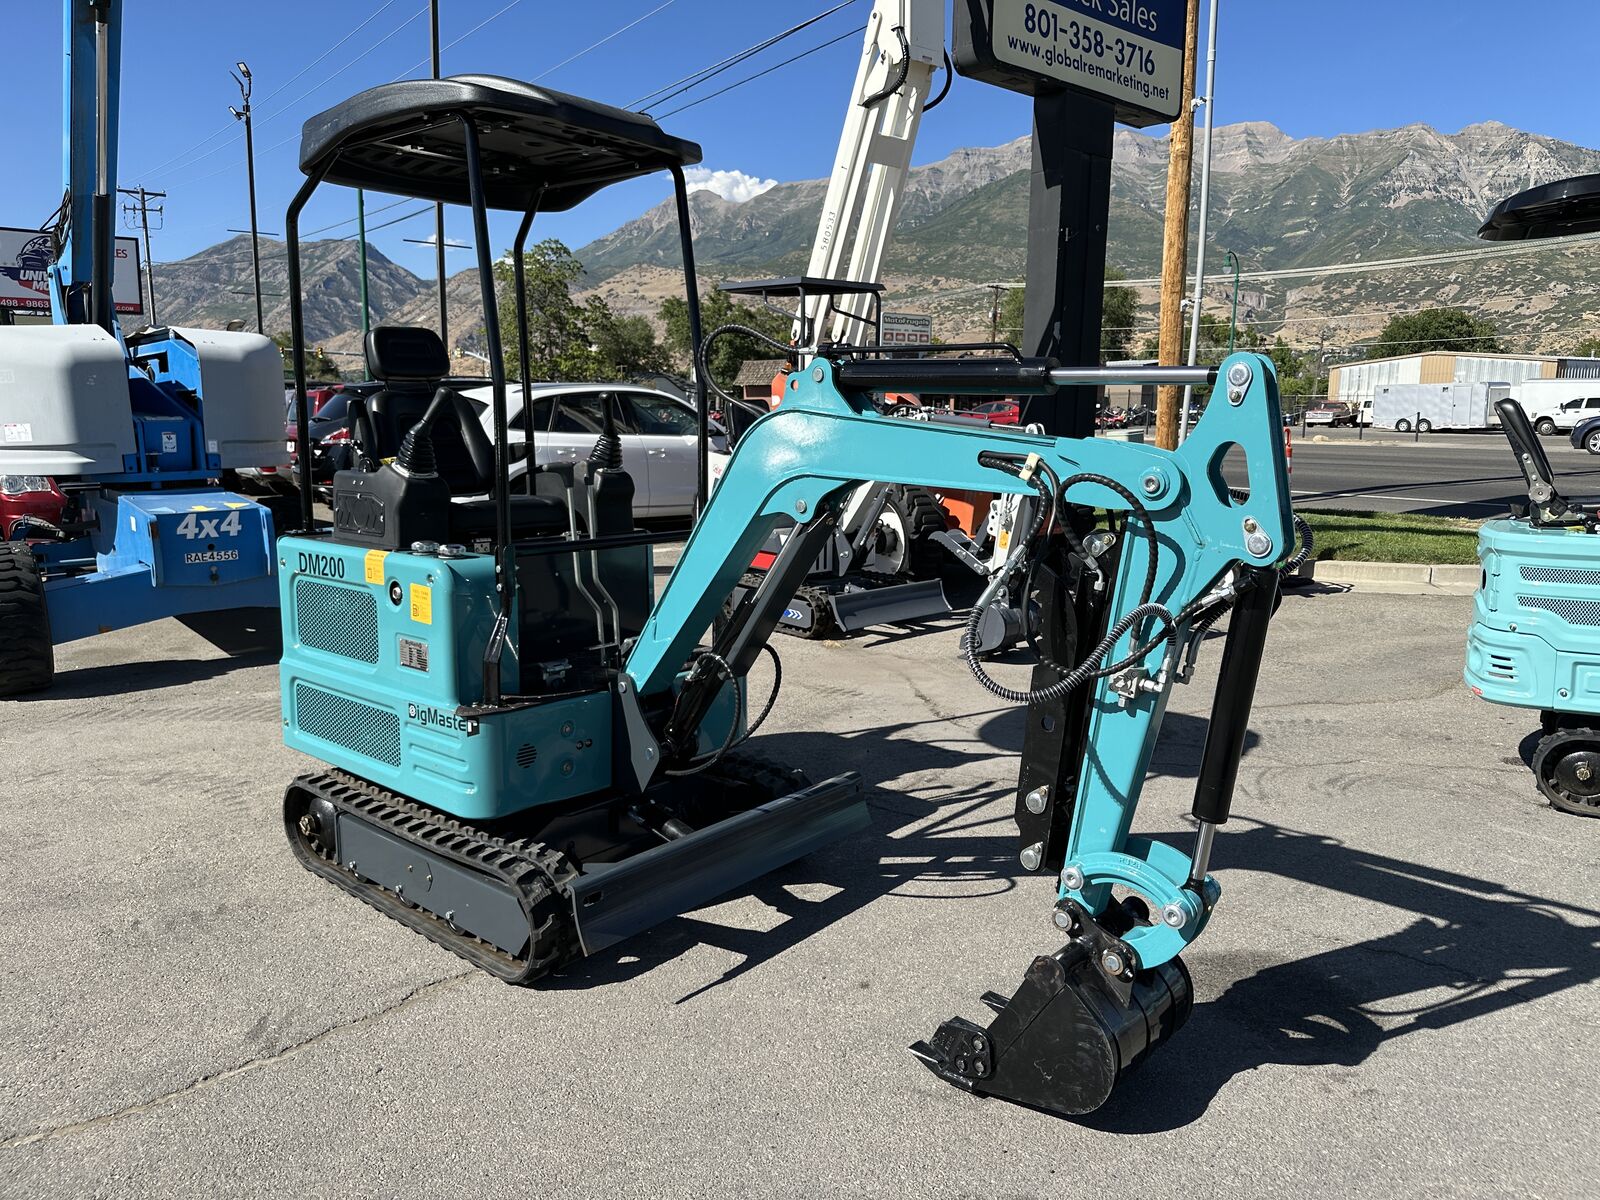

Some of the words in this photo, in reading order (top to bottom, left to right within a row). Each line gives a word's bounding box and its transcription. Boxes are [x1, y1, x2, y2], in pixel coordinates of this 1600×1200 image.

[1108, 0, 1157, 32] Sales
[1024, 3, 1156, 76] 801-358-3716
[1007, 35, 1169, 100] www.globalremarketing.net
[820, 211, 836, 251] 580533
[884, 315, 930, 327] MotoFrugals
[176, 511, 242, 540] 4x4
[186, 550, 238, 563] RAE4556
[298, 551, 345, 579] DM200
[408, 703, 480, 735] DigMaster
